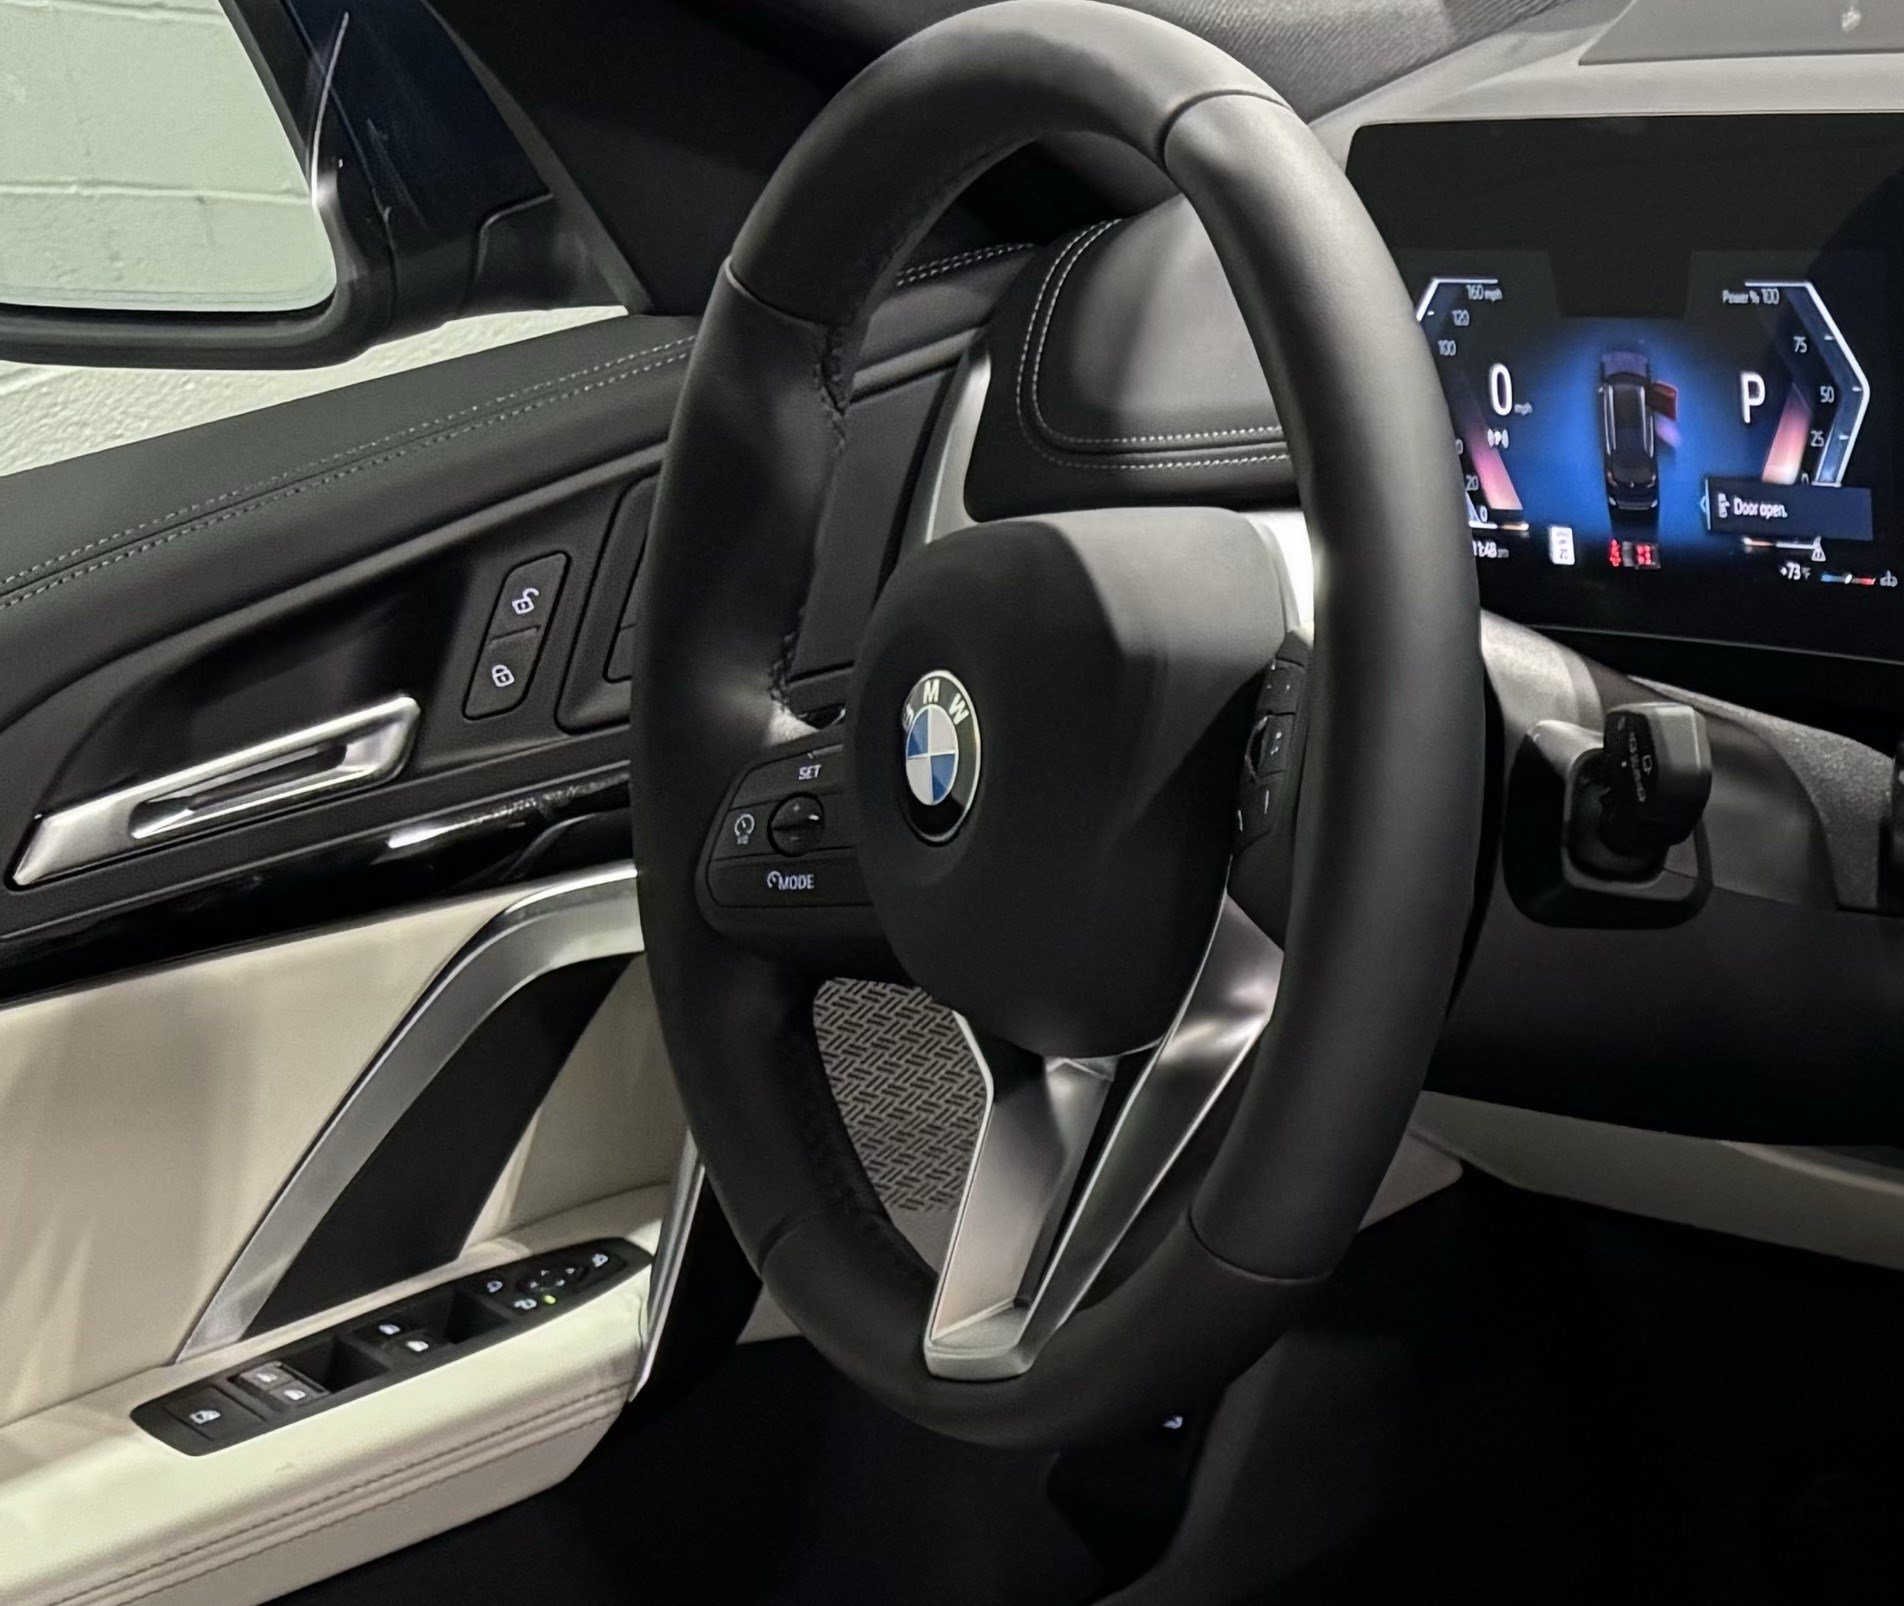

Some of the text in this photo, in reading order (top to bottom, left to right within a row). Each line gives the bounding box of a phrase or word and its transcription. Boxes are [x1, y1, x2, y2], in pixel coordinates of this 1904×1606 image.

[1761, 288, 1780, 305] 100
[1452, 309, 1470, 327] 120
[1438, 339, 1457, 356] 100
[1793, 336, 1808, 353] 75
[1490, 363, 1512, 416] 0
[1740, 372, 1766, 424] P
[1820, 386, 1835, 403] 50
[1811, 430, 1825, 447] 25
[1466, 475, 1479, 492] 20
[1480, 505, 1488, 522] 0
[1733, 496, 1758, 516] Door
[798, 764, 821, 780] SET
[779, 874, 815, 890] MODE
